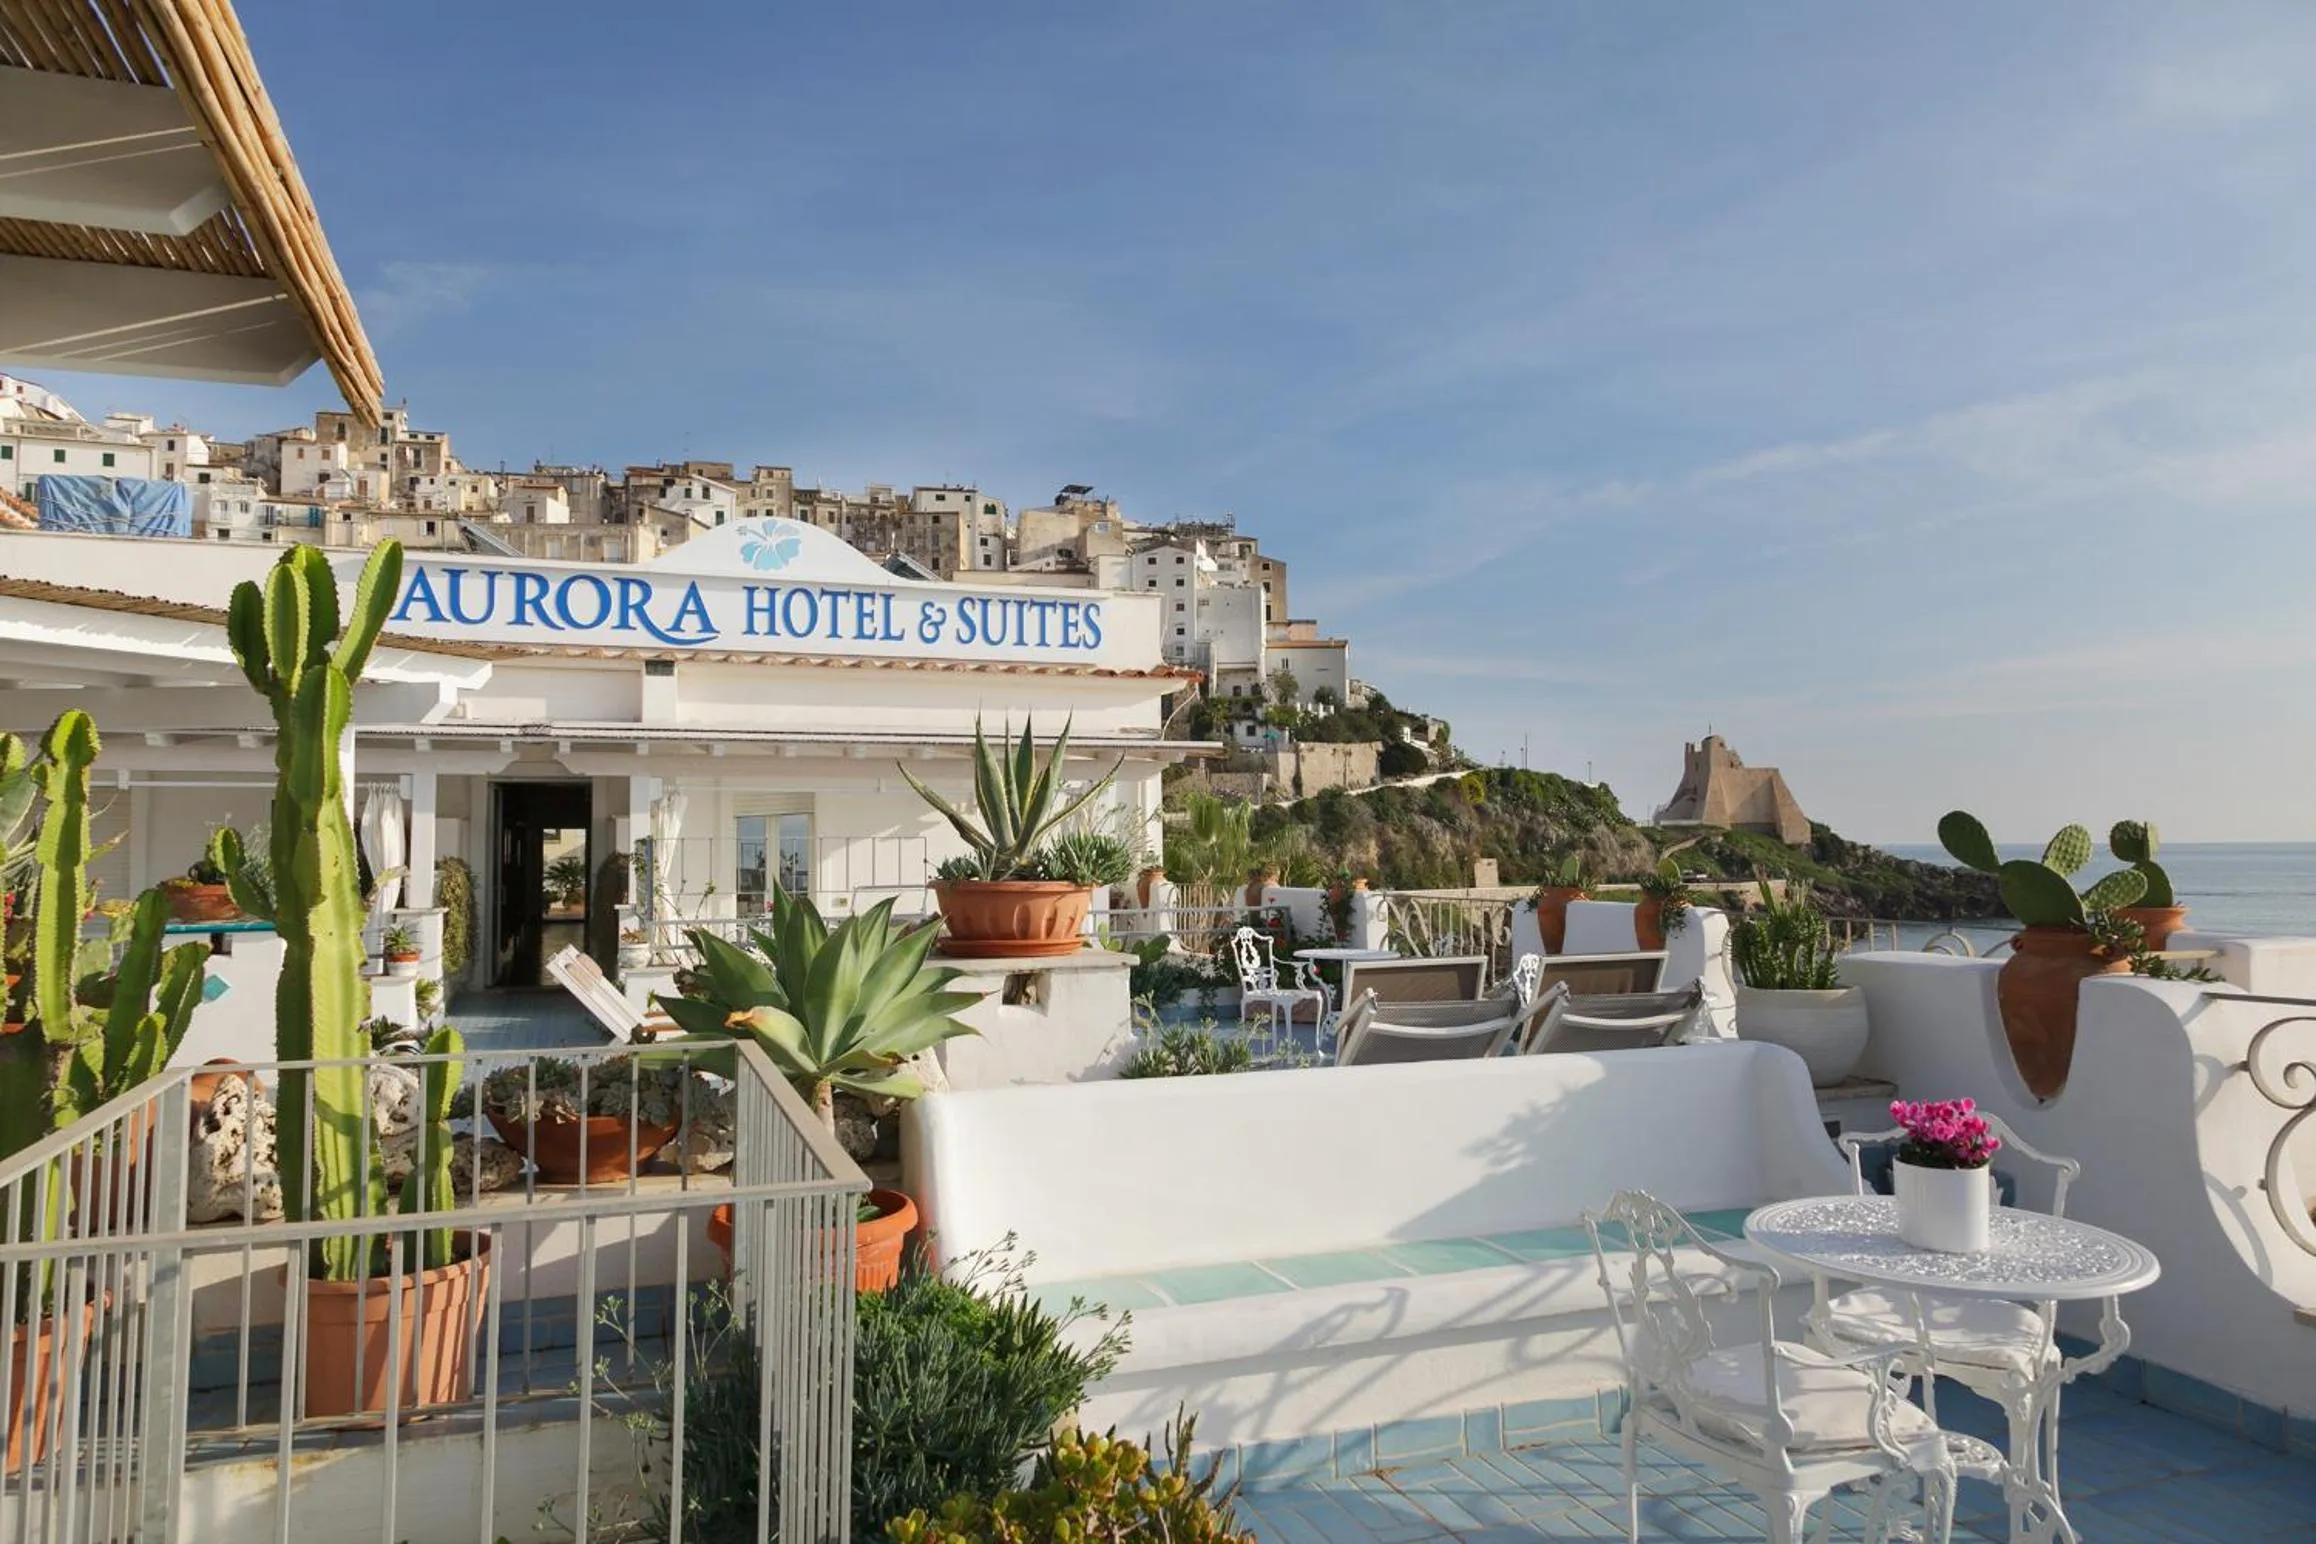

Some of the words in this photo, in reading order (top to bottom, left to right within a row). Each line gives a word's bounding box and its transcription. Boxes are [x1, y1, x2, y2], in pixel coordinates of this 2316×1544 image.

[389, 565, 722, 646] AURORA
[742, 585, 905, 641] HOTEL
[919, 600, 947, 644] &
[956, 596, 1101, 649] SUITES
